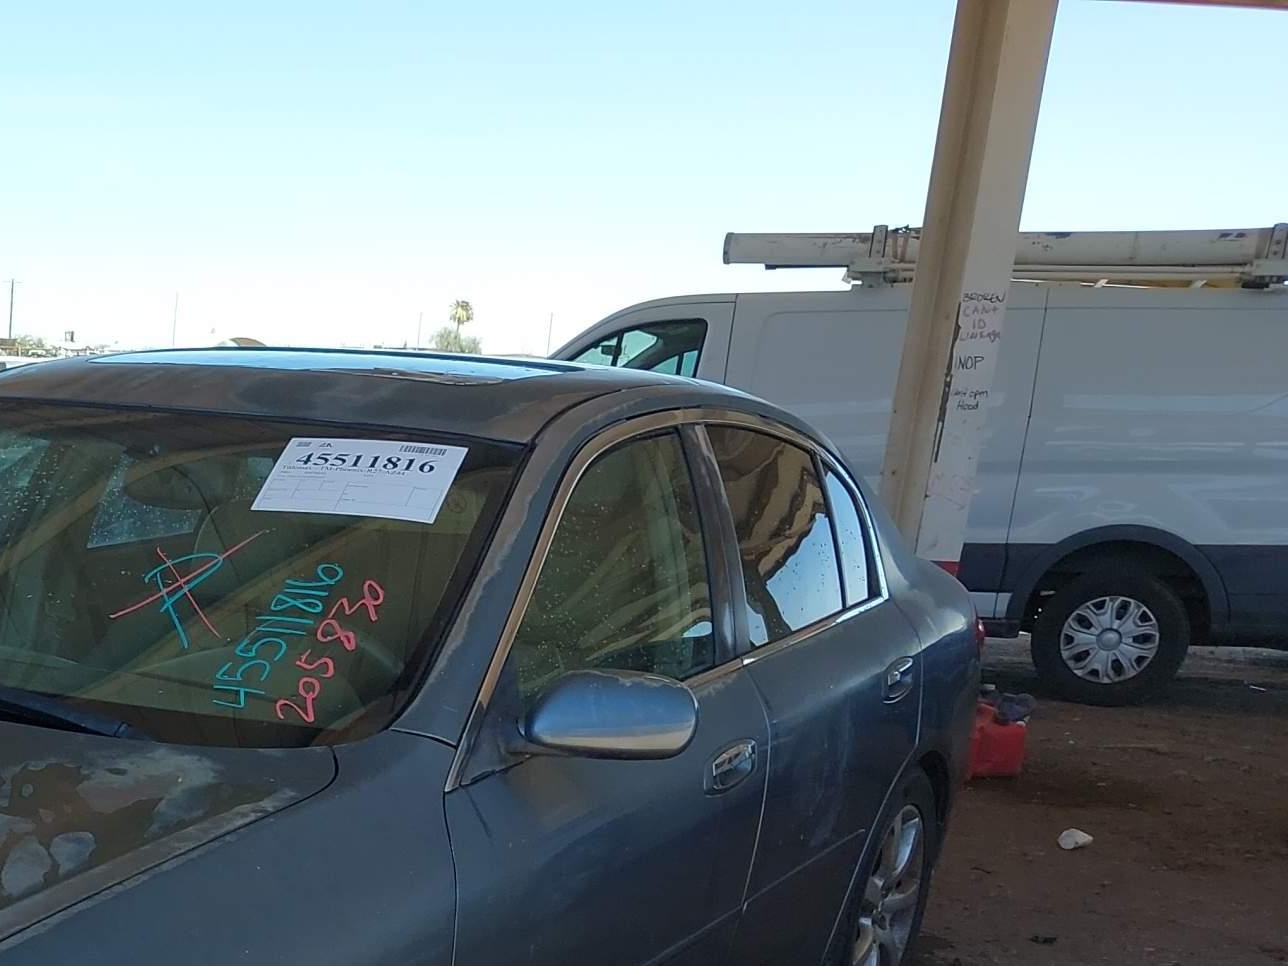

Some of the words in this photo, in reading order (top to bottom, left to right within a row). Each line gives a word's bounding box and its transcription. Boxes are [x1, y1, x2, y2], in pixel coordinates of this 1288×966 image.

[955, 355, 985, 371] INOP
[296, 451, 440, 474] 45511816
[212, 562, 344, 709] 45511816
